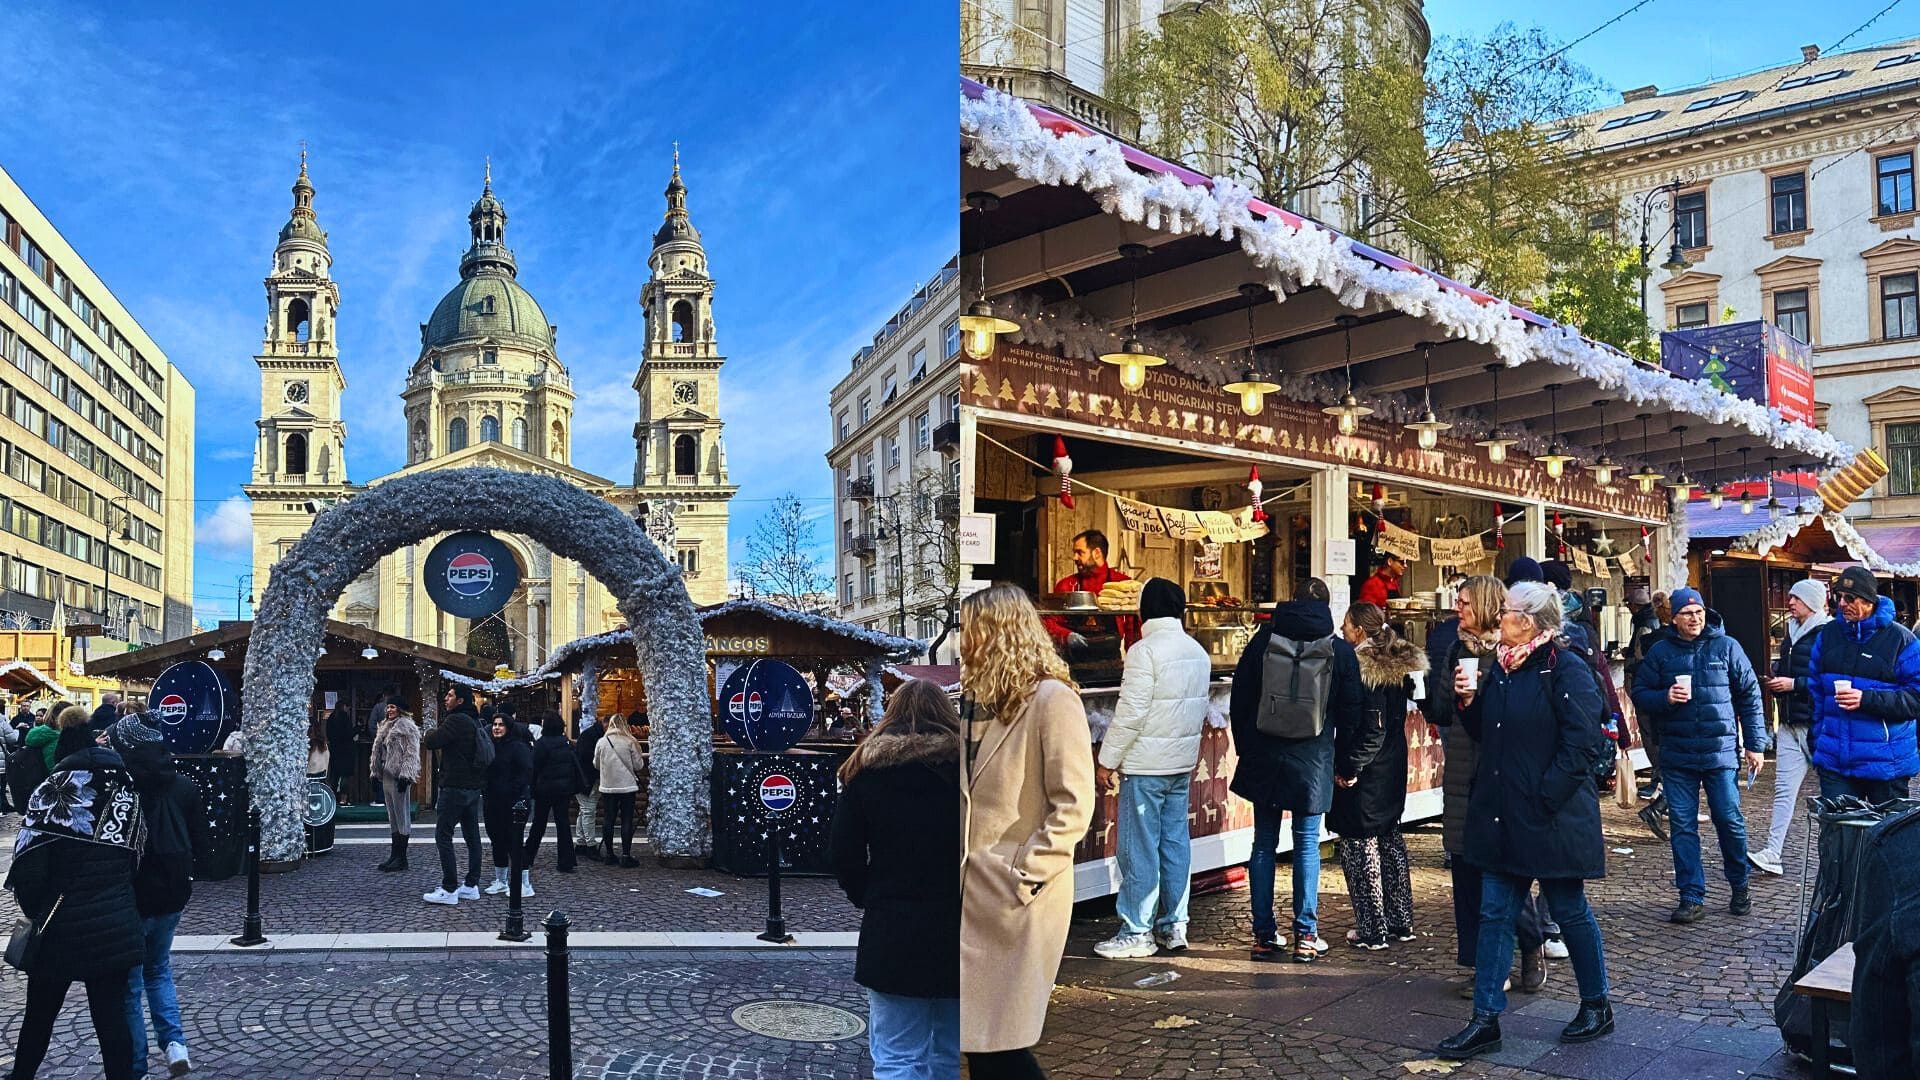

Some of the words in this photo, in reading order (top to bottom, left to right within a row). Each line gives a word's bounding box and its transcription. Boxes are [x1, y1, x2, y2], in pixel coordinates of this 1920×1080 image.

[1010, 347, 1034, 358] MERRY
[1035, 352, 1074, 367] CHRISTMAS
[1002, 356, 1018, 365] AND
[1019, 360, 1043, 371] HAPPY
[1044, 364, 1060, 373] NEW
[1061, 367, 1081, 378] YEAR!
[1144, 369, 1177, 387] OTATO
[1153, 388, 1214, 412] HUNGARIAN
[1216, 401, 1241, 416] STEW
[1143, 522, 1162, 533] DOG
[449, 568, 491, 579] PEPSI
[704, 634, 768, 652] ÁNGOS
[762, 788, 793, 797] PEPSI
